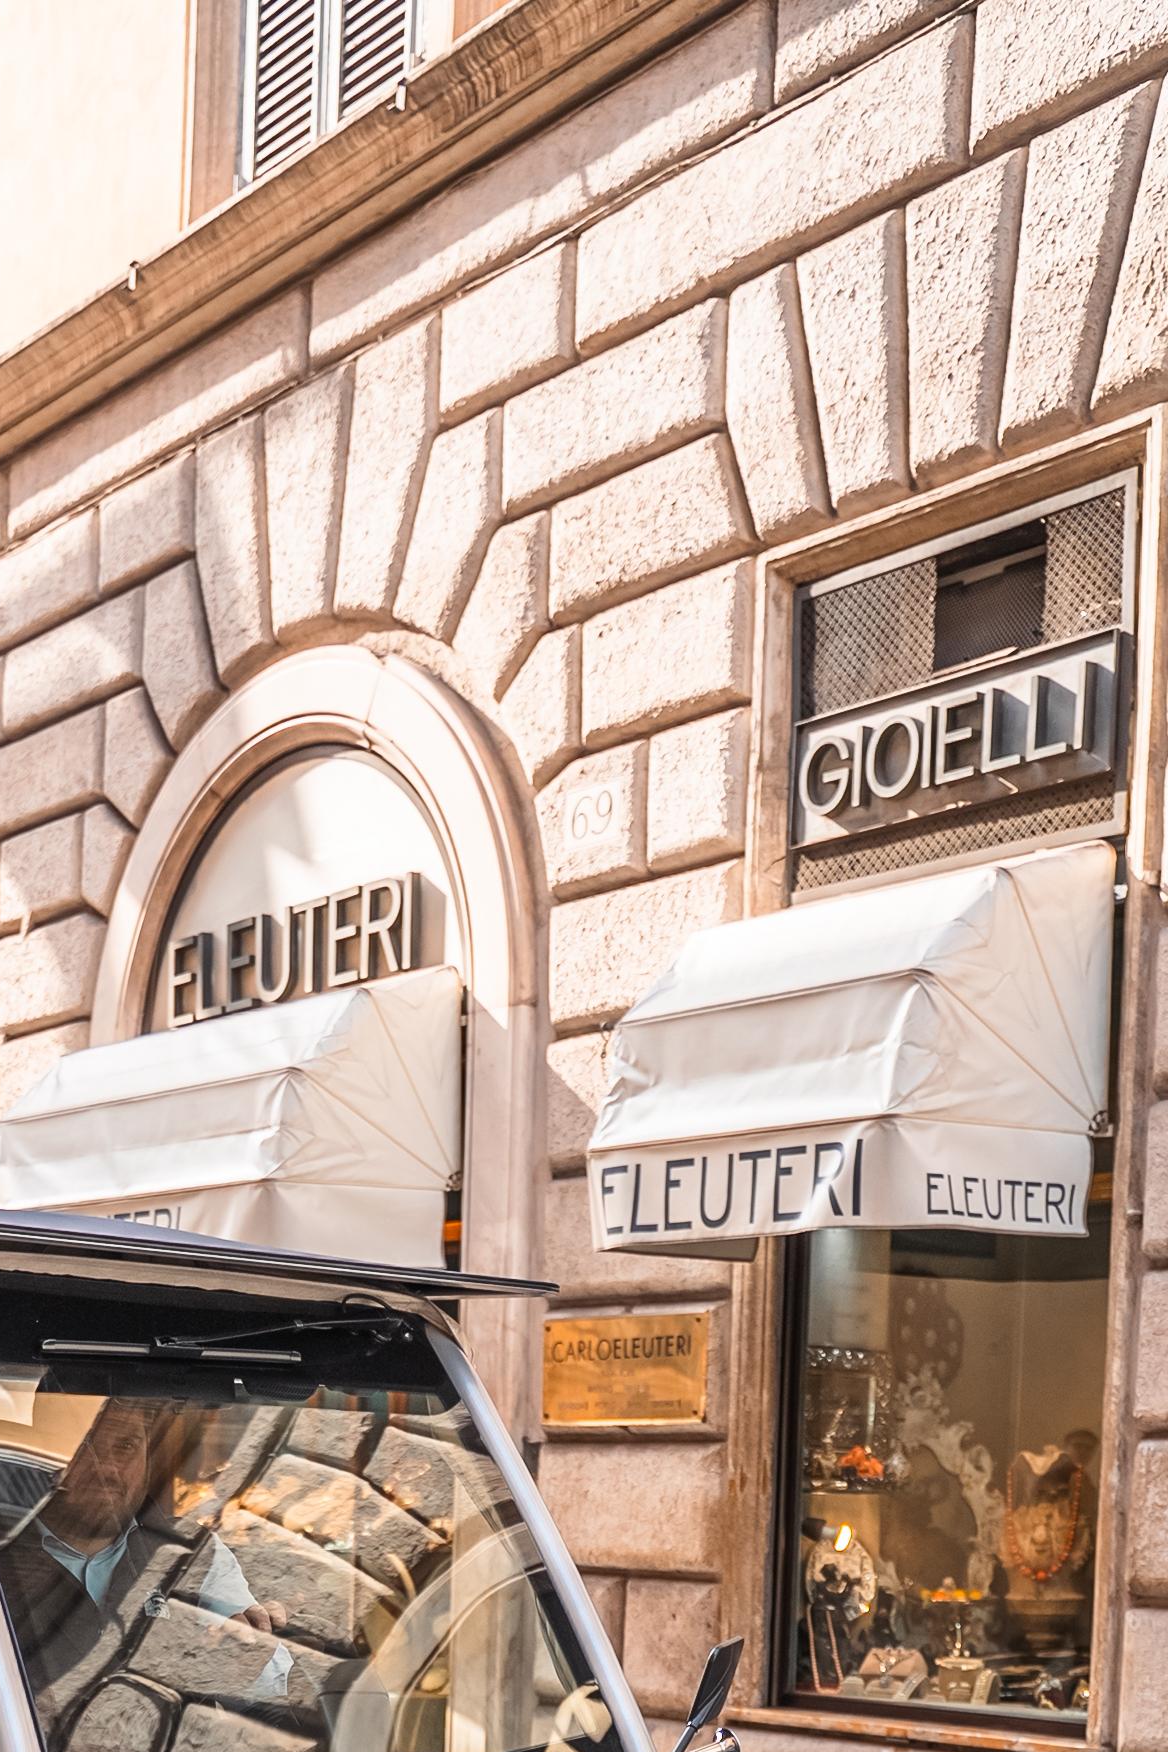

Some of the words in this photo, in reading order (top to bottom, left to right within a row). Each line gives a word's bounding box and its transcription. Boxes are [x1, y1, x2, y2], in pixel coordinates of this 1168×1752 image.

[799, 661, 1099, 816] GIOIELLI
[571, 790, 613, 840] 69
[166, 872, 422, 1029] ELEUTERI
[601, 1139, 864, 1236] ELEUTERI
[926, 1172, 1076, 1226] ELEUTERI
